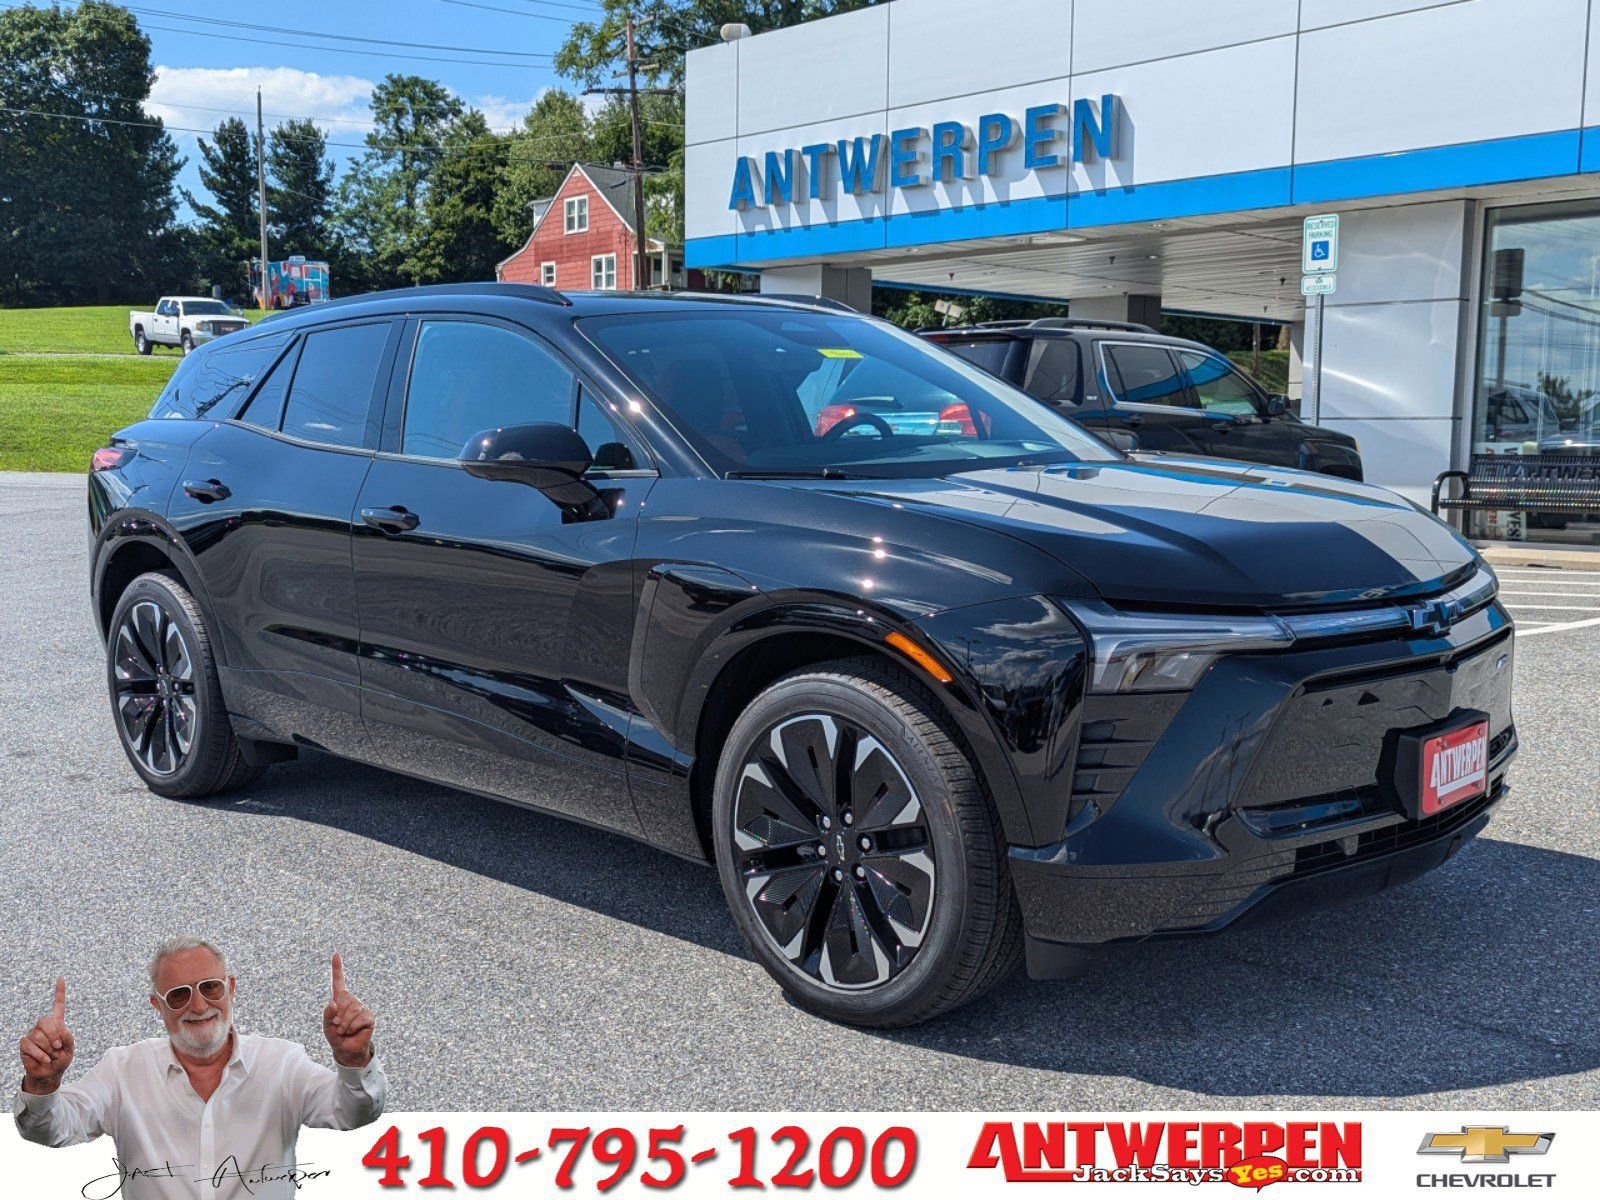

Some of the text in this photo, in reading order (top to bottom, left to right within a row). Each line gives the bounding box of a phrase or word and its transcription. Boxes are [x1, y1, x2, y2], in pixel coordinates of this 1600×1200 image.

[729, 93, 1120, 210] ANTWERPEN
[1306, 221, 1335, 230] RESERVED
[1308, 230, 1333, 239] PARKING
[1430, 736, 1486, 797] ANTWERPEN
